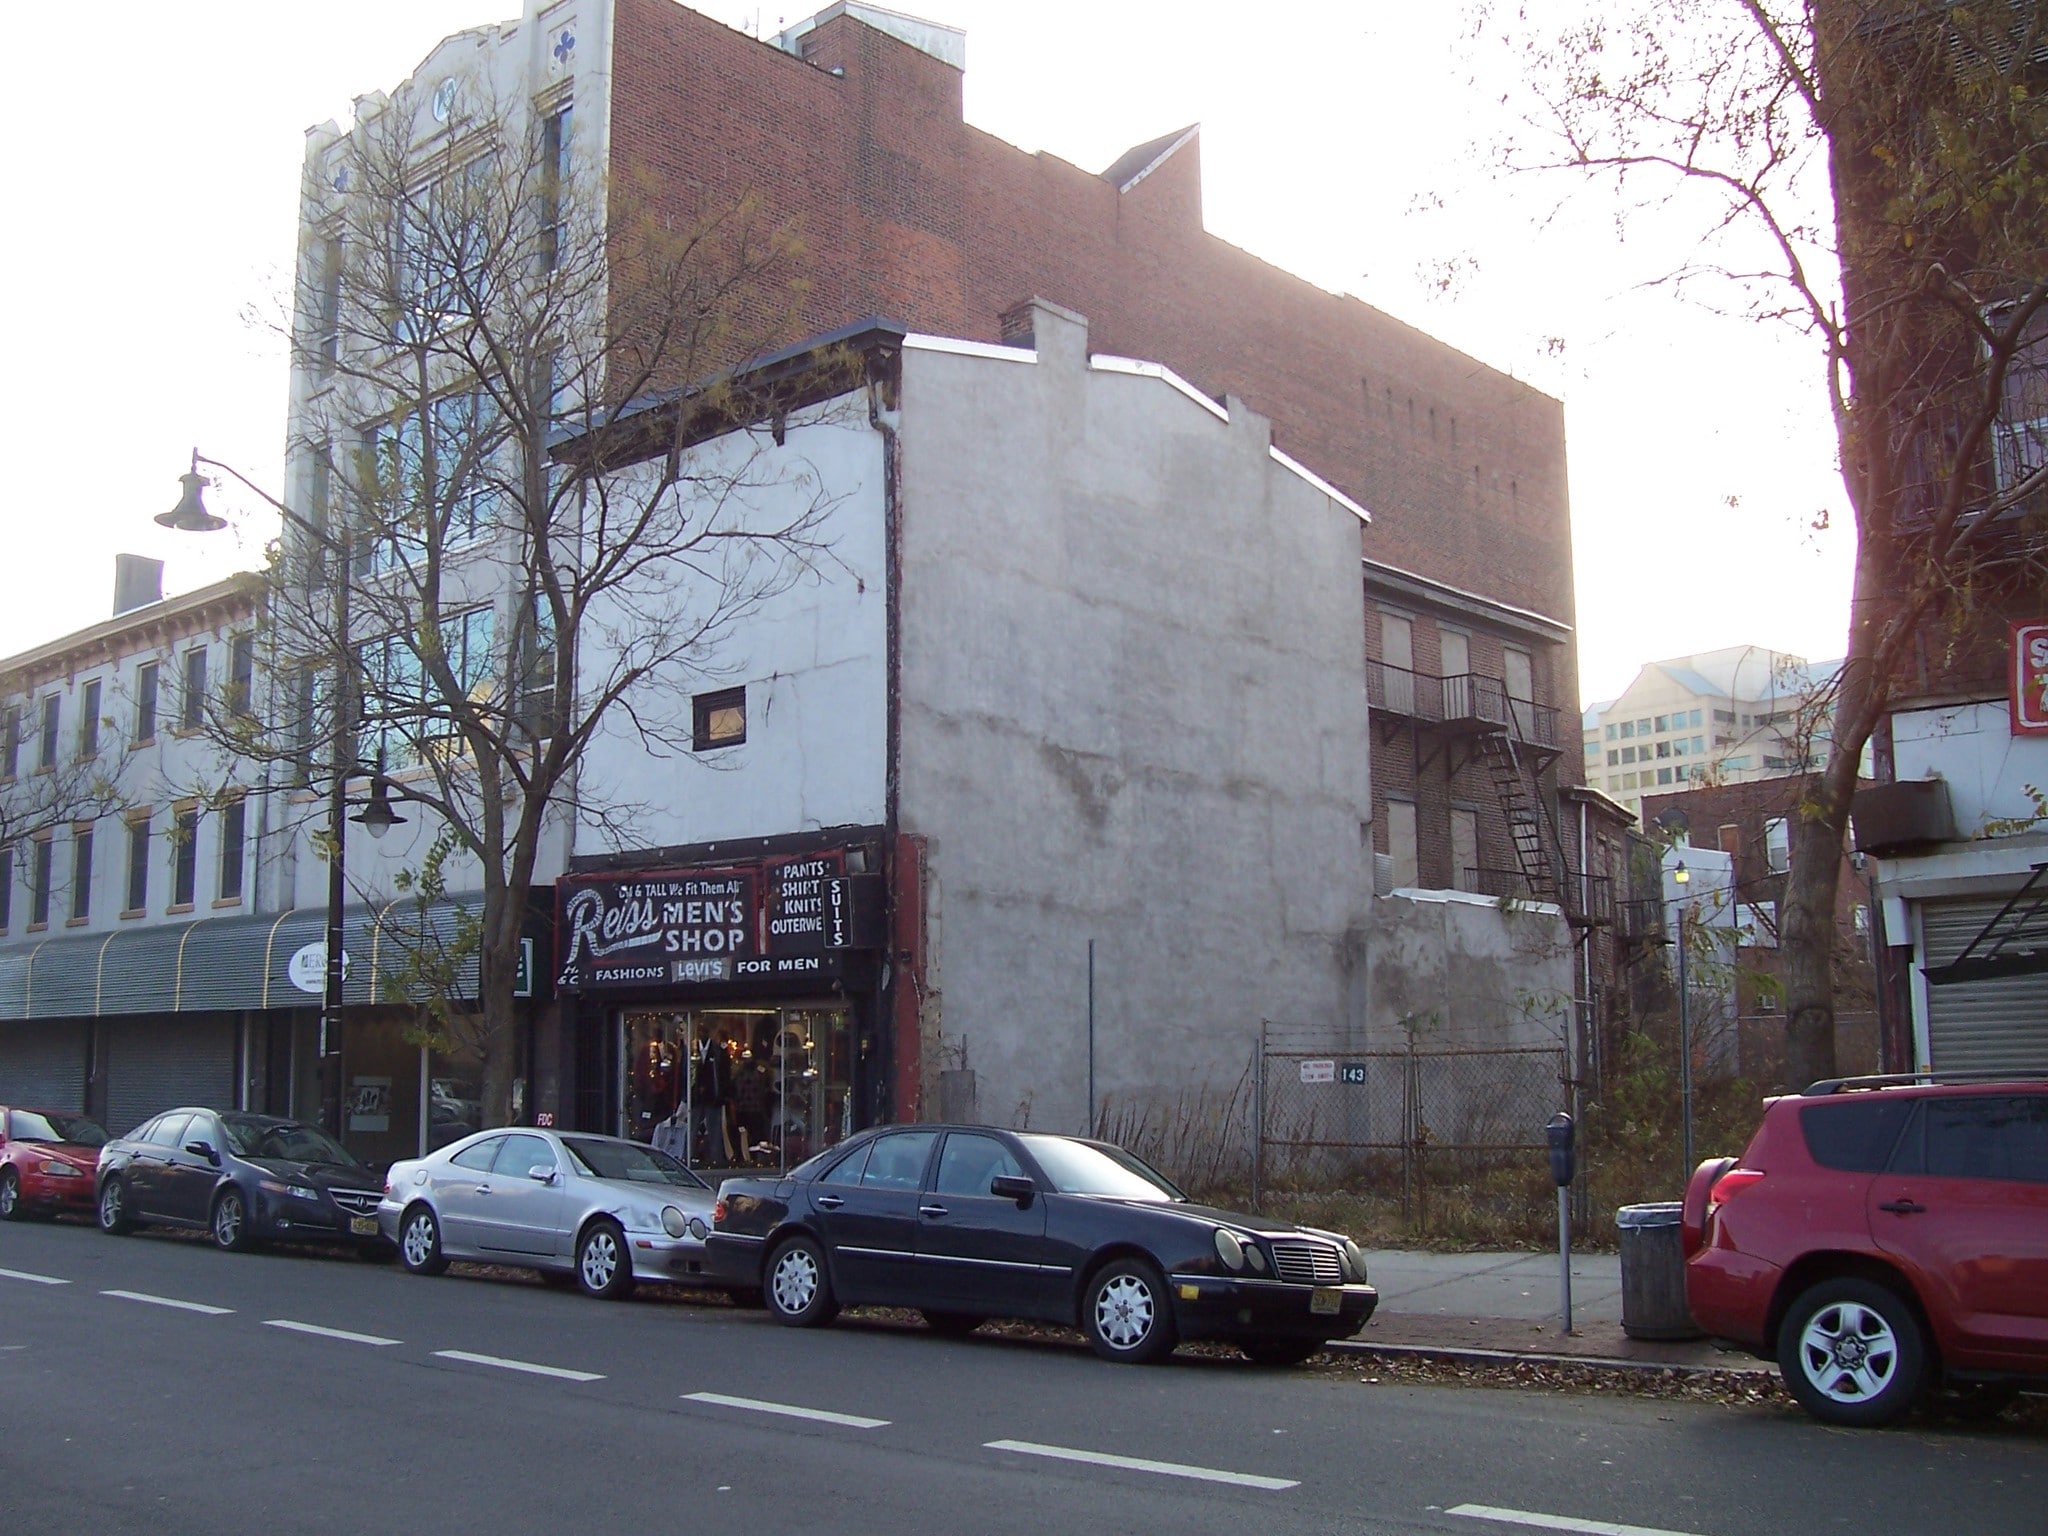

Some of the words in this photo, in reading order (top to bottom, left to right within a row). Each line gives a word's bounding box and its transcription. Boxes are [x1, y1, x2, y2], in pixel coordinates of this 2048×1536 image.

[783, 861, 824, 878] PANTS
[635, 884, 642, 897] &
[645, 883, 667, 897] TALL
[685, 882, 698, 895] Fit
[700, 881, 725, 895] Them
[663, 901, 743, 924] MEN'S
[831, 880, 843, 946] SUITS
[566, 889, 663, 964] Reiss
[665, 929, 744, 952] SHOP
[595, 966, 664, 981] FASHIONS
[737, 961, 771, 974] FOR
[778, 958, 819, 971] MEN
[1342, 1068, 1364, 1081] 143
[537, 1113, 553, 1126] FDC
